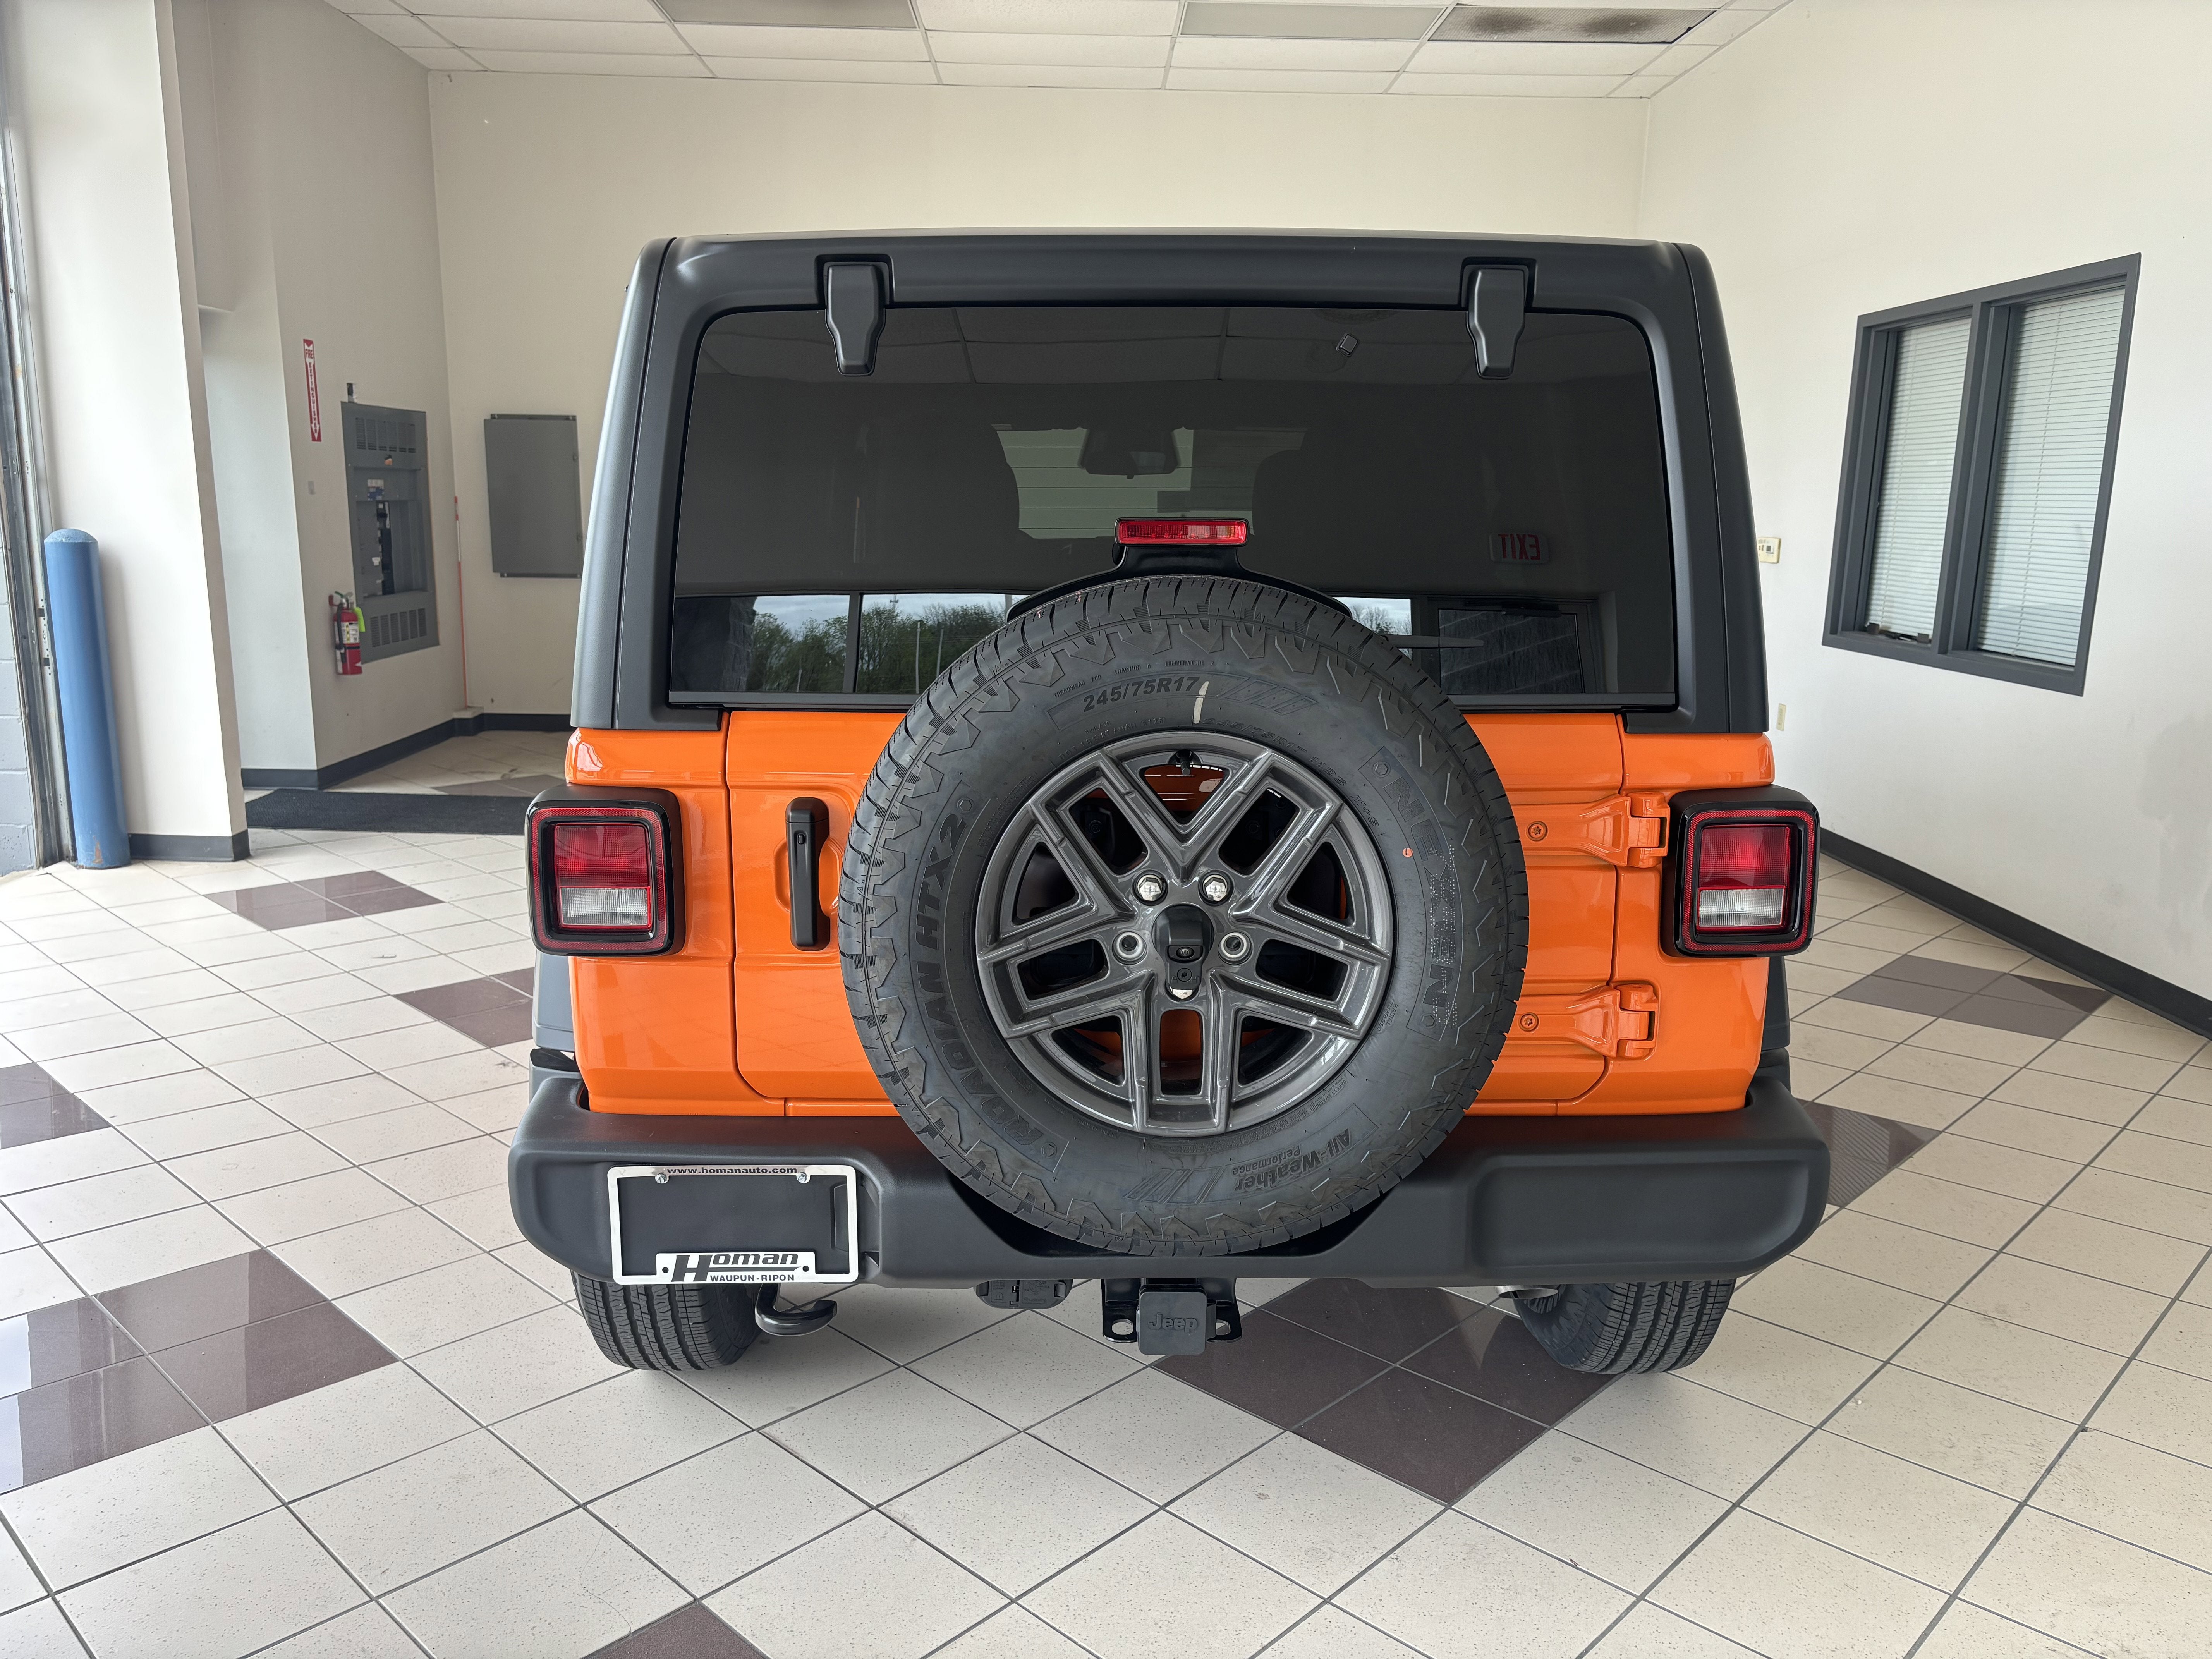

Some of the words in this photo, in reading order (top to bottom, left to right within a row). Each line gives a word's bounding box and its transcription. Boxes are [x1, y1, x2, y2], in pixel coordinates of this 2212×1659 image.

[1083, 677, 1200, 712] 245/75R17
[1202, 717, 1308, 753] 245/75R17
[915, 813, 967, 950] HTX2
[1382, 776, 1456, 1008] NEXEN
[1377, 1002, 1393, 1031] TUBELESS
[1386, 1003, 1398, 1025] RADIAL
[916, 961, 1044, 1146] ROADIAN
[1232, 1145, 1301, 1175] Performance
[1234, 1127, 1352, 1192] All-Weather
[671, 1253, 800, 1282] Homan
[1148, 1313, 1198, 1334] Jeep
